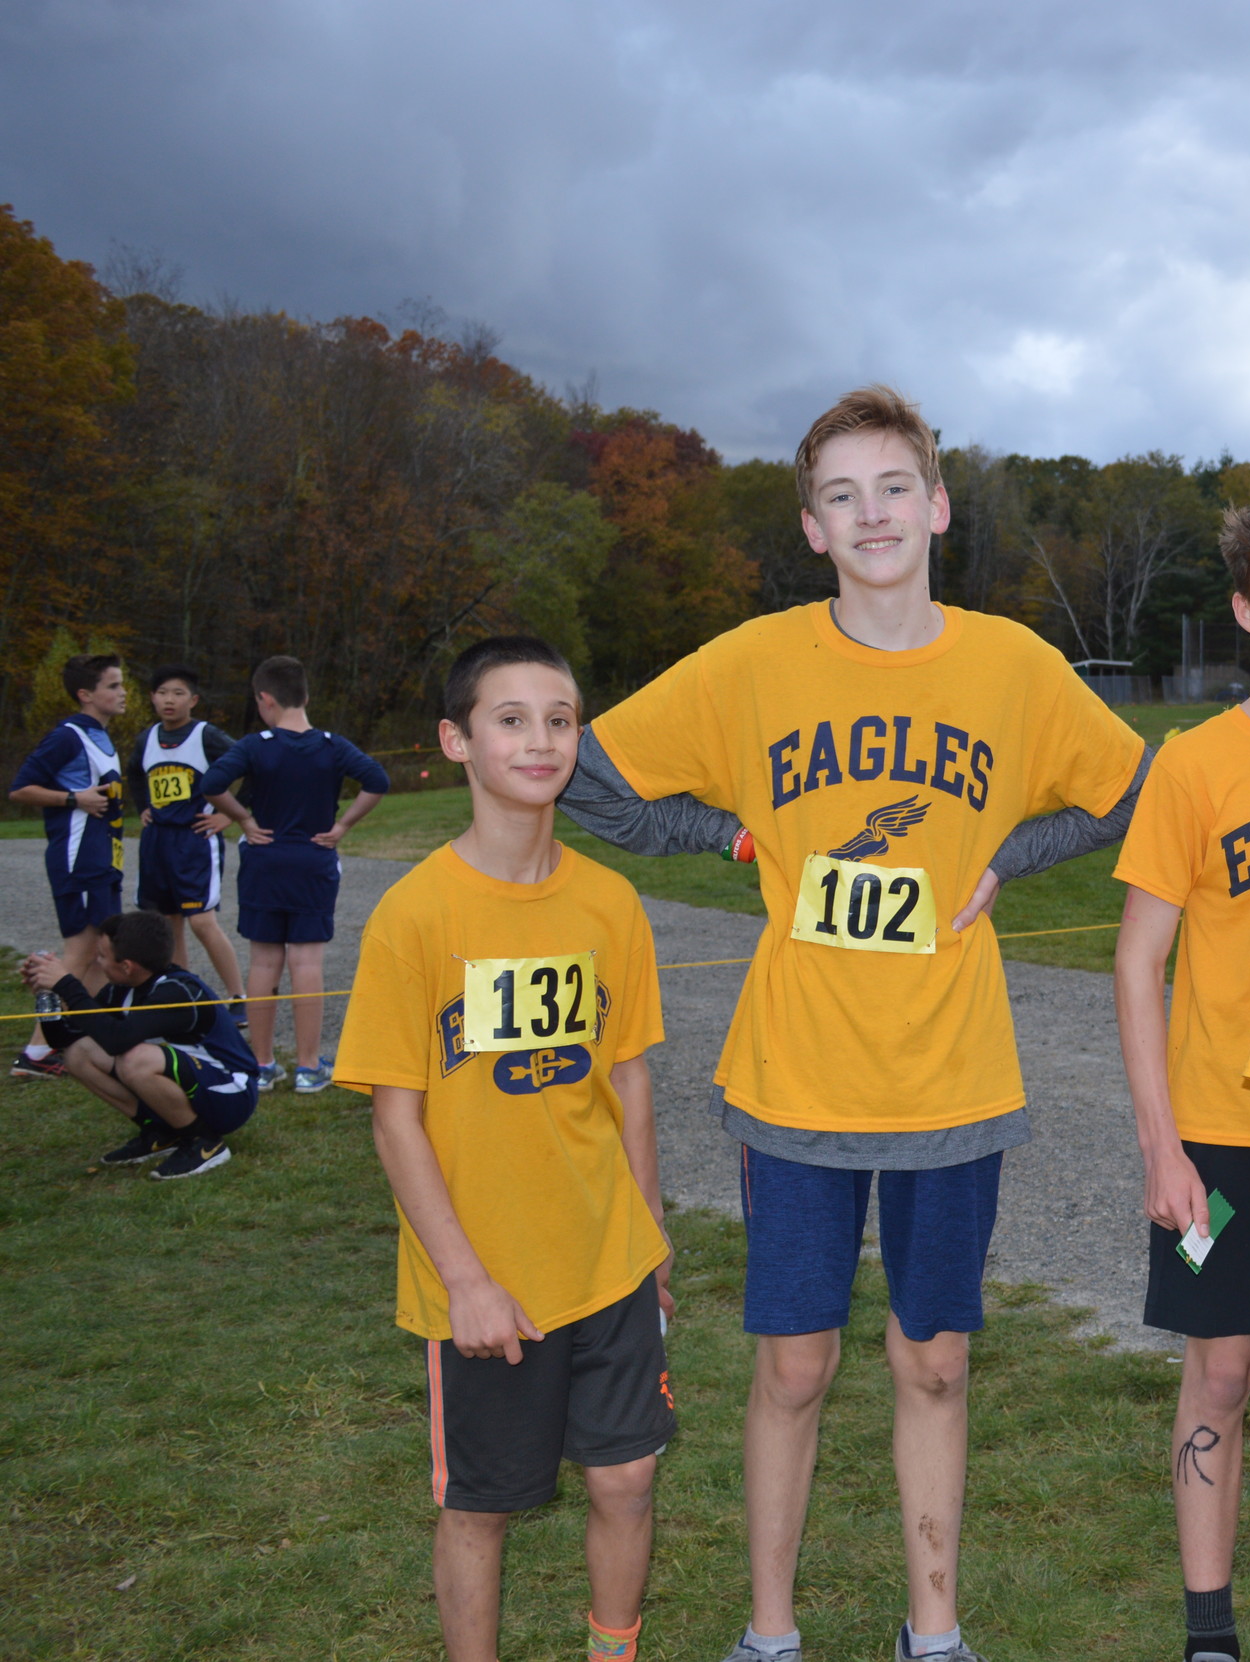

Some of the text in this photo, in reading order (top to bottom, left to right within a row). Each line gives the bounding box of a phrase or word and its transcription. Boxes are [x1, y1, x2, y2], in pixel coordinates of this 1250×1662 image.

[153, 776, 182, 800] 823
[768, 715, 994, 813] EAGLES
[815, 868, 920, 943] 102
[493, 963, 587, 1040] 132
